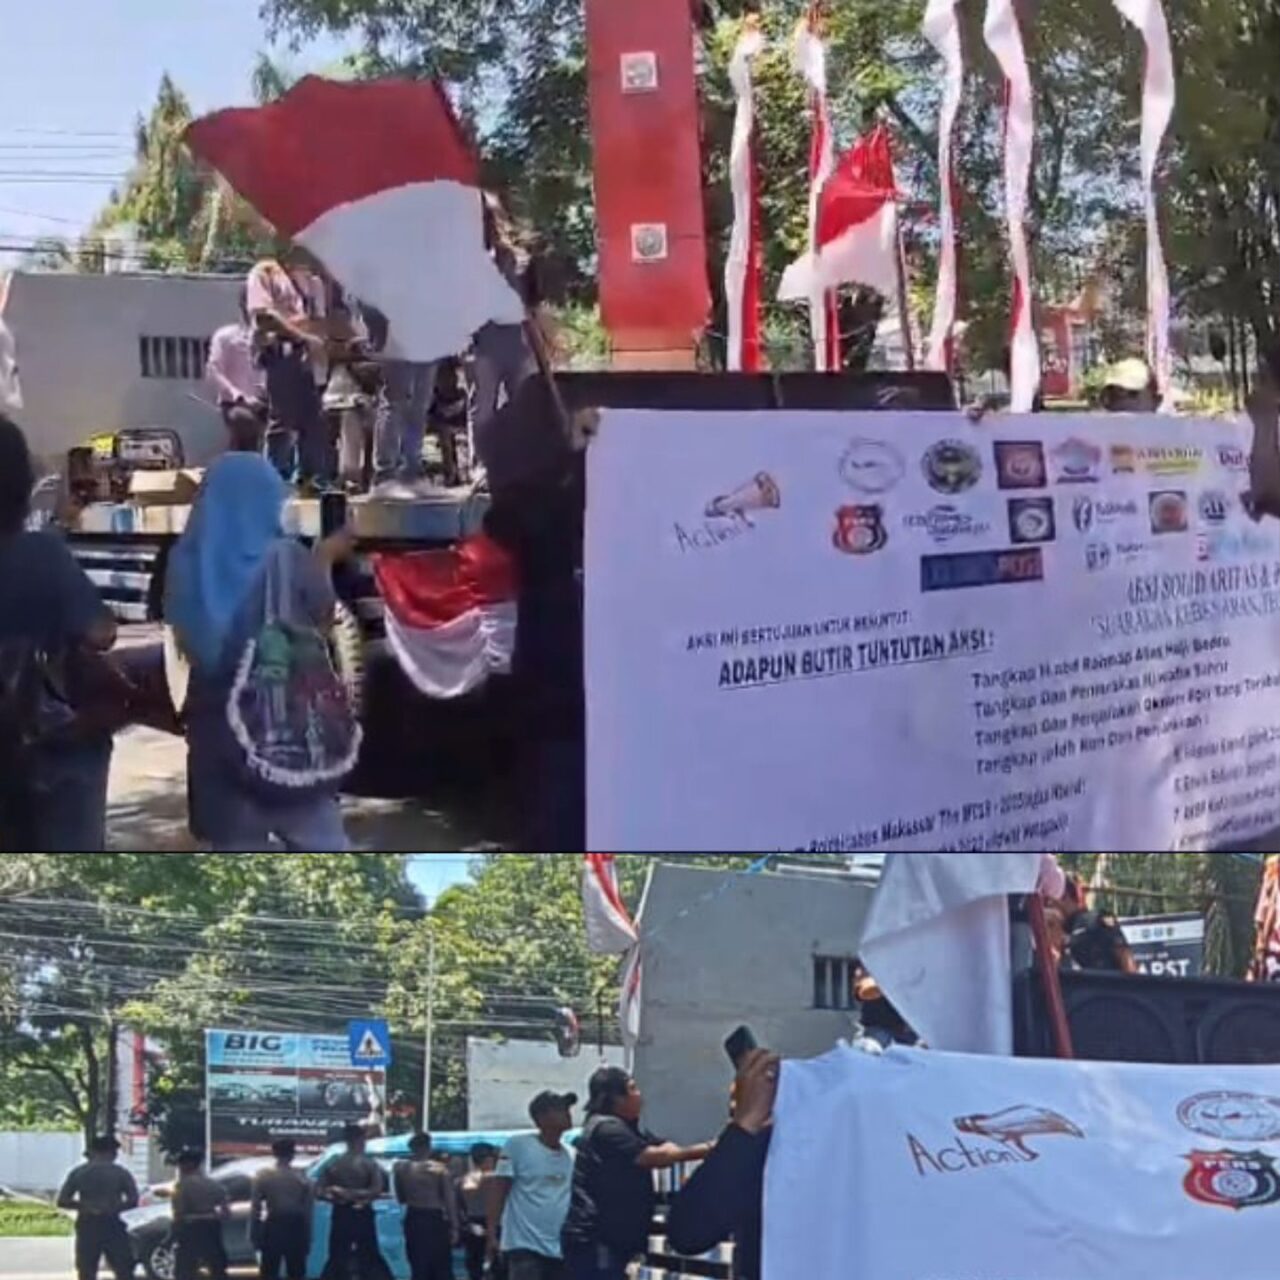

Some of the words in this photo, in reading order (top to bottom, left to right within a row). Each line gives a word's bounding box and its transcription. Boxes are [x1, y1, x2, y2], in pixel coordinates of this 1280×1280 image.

[719, 651, 797, 687] ADAPUN
[801, 643, 854, 675] BUTIR
[857, 634, 943, 668] TUNTUTAN
[948, 630, 986, 658] AKSI
[224, 1034, 282, 1051] BIG
[906, 1132, 1018, 1176] Action
